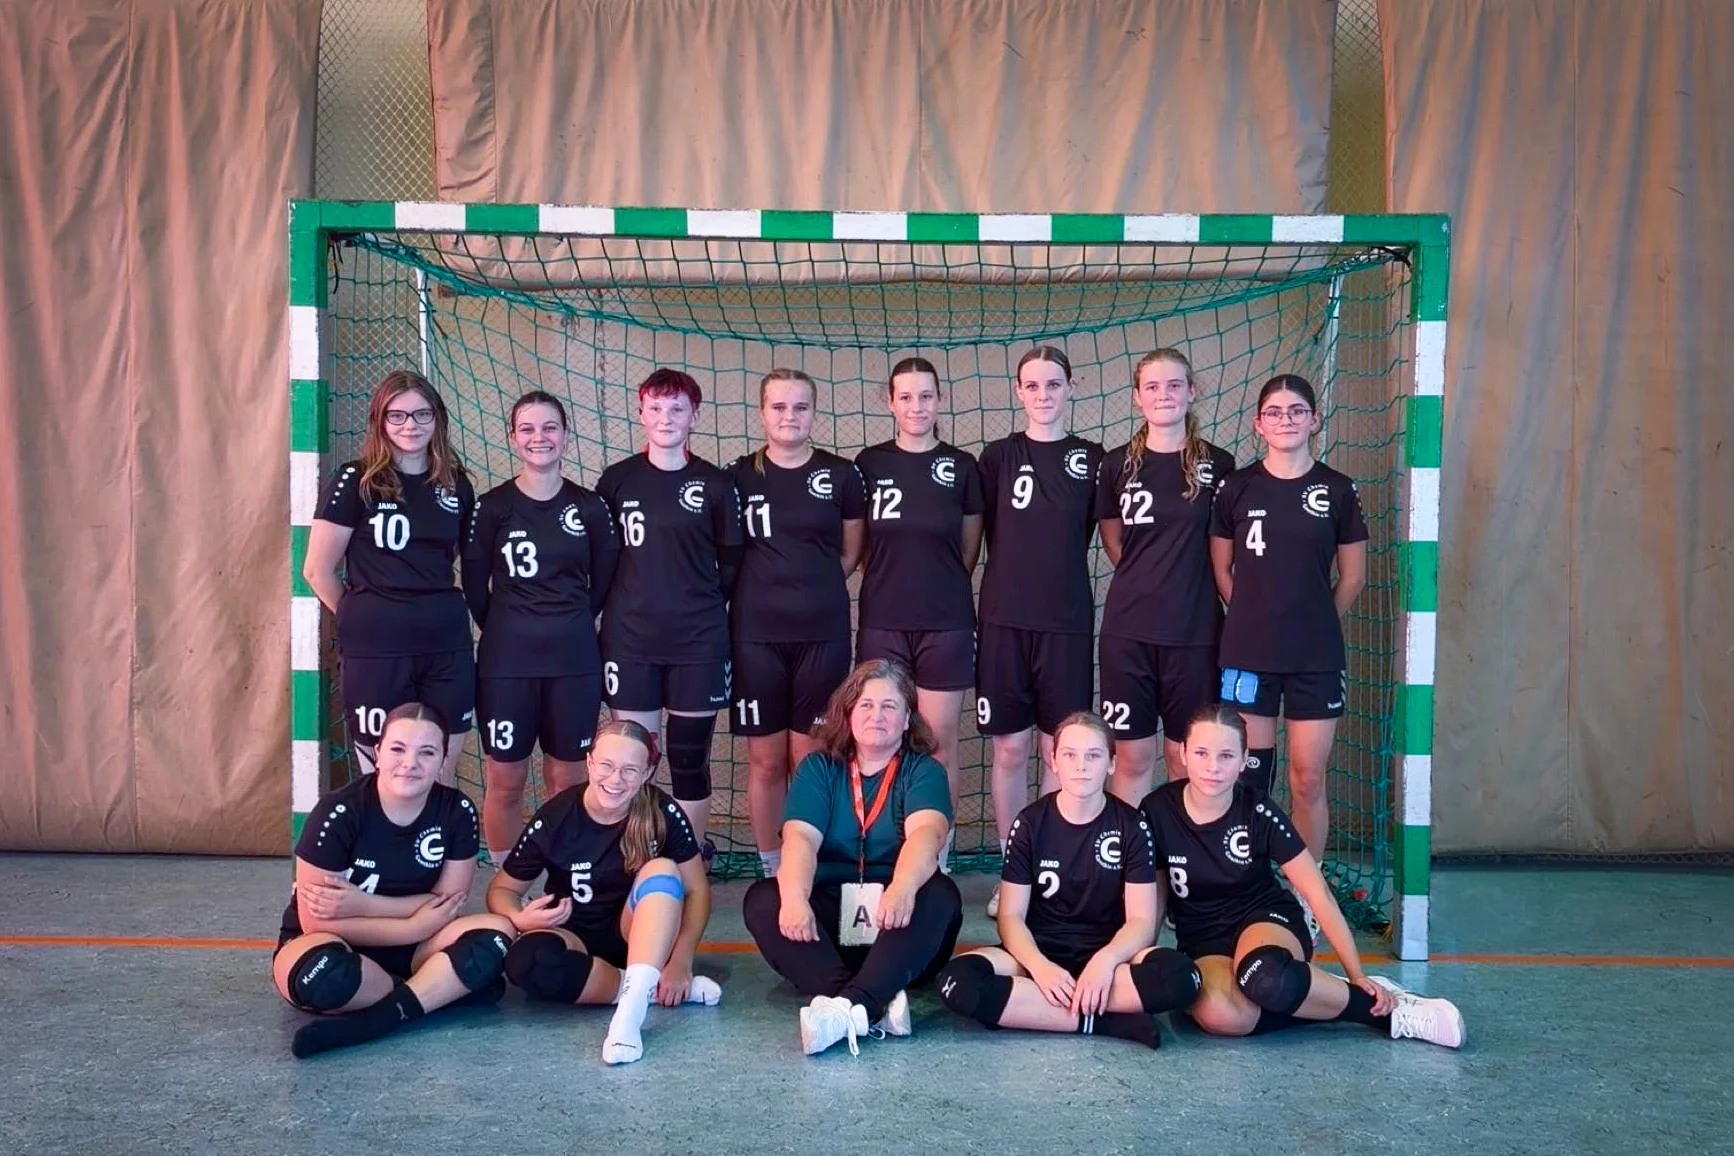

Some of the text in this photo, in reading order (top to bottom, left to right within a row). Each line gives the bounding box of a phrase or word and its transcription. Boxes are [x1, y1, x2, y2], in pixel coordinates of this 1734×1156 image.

[873, 488, 902, 520] 12
[1012, 476, 1033, 509] 9
[1120, 489, 1154, 525] 22
[369, 513, 410, 550] 10
[620, 511, 644, 546] 16
[745, 503, 771, 537] 11
[1246, 520, 1266, 556] 4
[502, 541, 538, 577] 13
[355, 706, 386, 736] 10
[737, 699, 759, 725] 11
[978, 698, 990, 724] 9
[1103, 701, 1130, 729] 22
[488, 719, 513, 749] 13
[355, 859, 375, 868] JAKO
[571, 862, 591, 870] JAKO
[1040, 860, 1059, 868] JAKO
[1169, 856, 1187, 864] JAKO
[571, 872, 593, 903] 5
[1170, 867, 1188, 897] 8
[853, 905, 872, 928] A
[1240, 959, 1262, 987] Kempa
